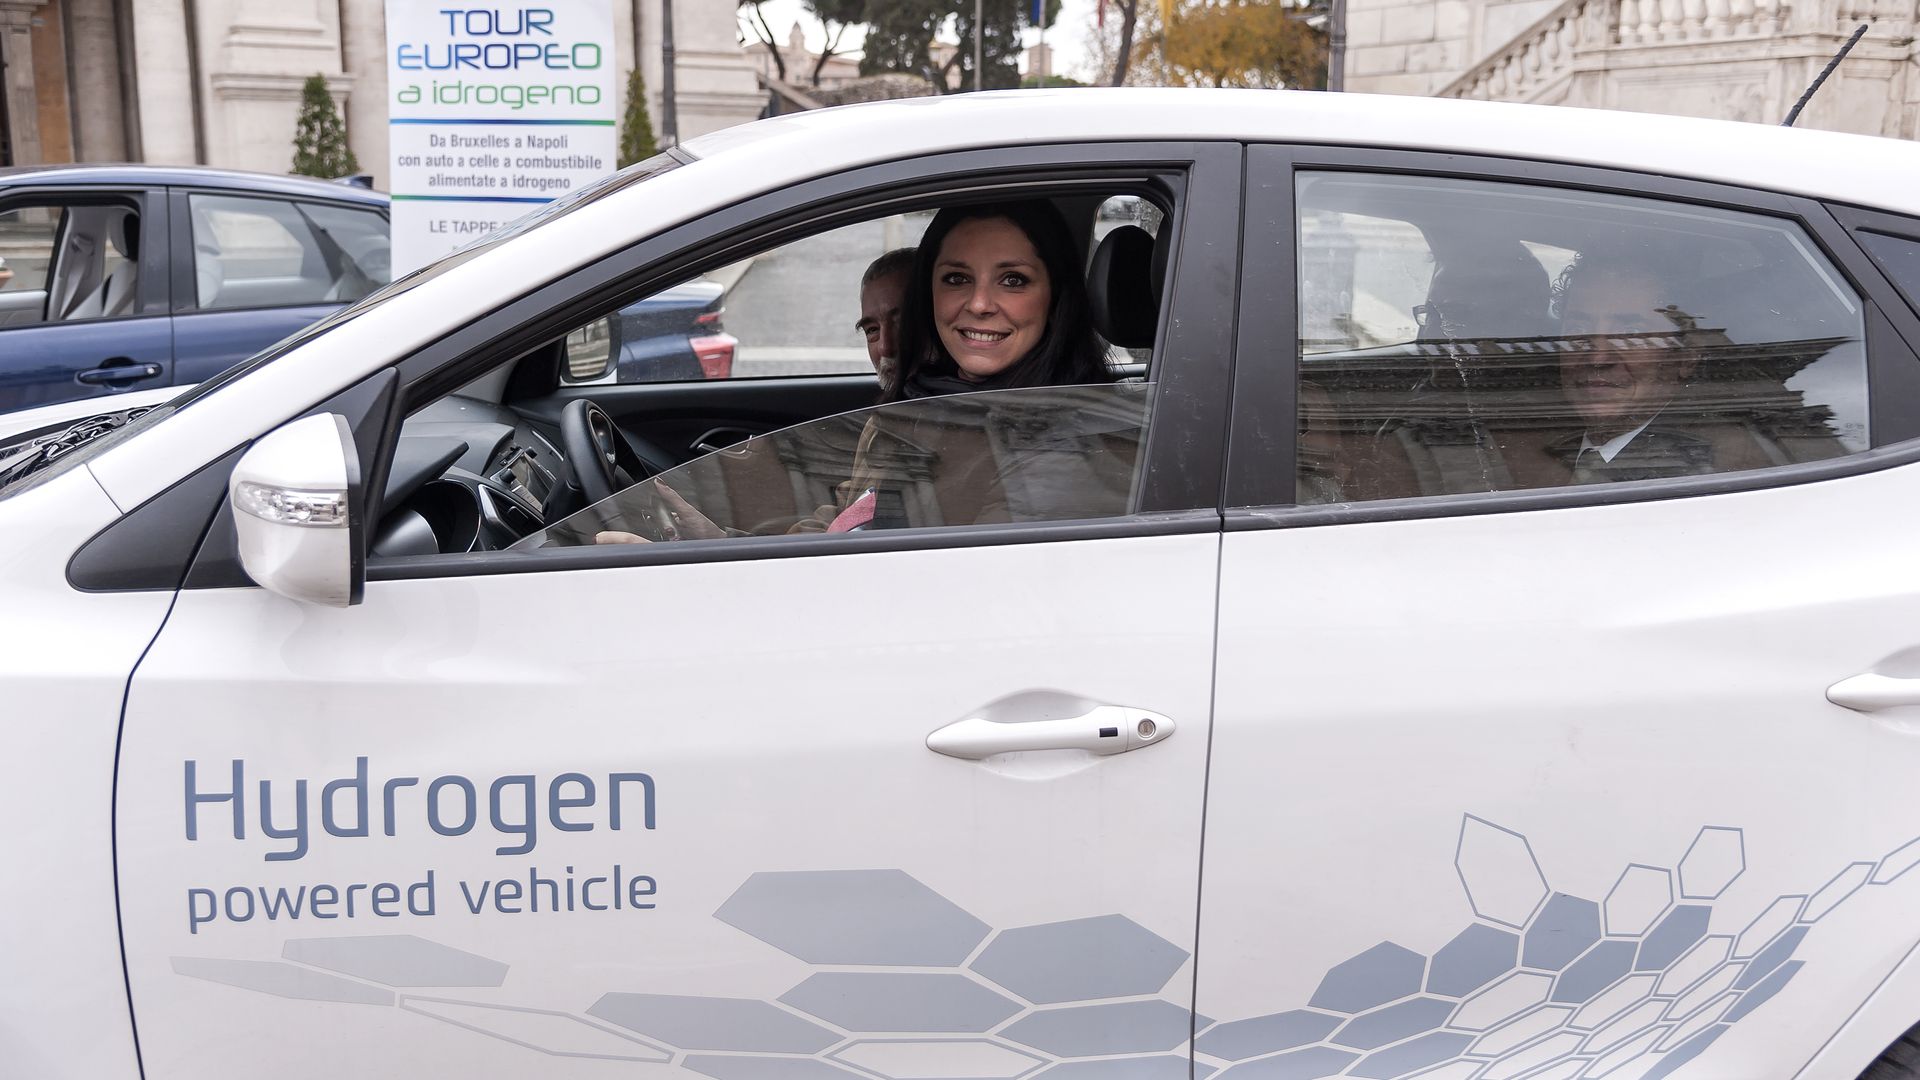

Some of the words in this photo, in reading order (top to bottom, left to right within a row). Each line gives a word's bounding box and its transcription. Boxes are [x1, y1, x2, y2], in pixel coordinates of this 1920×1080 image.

[440, 9, 554, 36] TOUR
[397, 43, 601, 70] EUROPEO
[397, 85, 421, 104] a
[432, 80, 601, 109] idrogeno
[430, 134, 446, 148] Da
[451, 134, 510, 148] Bruxelles
[515, 137, 522, 148] a
[527, 135, 568, 151] Napoli
[398, 155, 421, 167] con
[426, 155, 454, 167] auto
[457, 156, 465, 168] a
[469, 154, 500, 168] celle
[504, 157, 511, 168] a
[516, 155, 602, 169] combustibile
[428, 174, 496, 188] alimentate
[500, 177, 508, 188] a
[513, 175, 570, 191] idrogeno
[430, 220, 447, 233] LE
[184, 756, 656, 862] Hydrogen
[188, 870, 435, 935] powered
[459, 864, 657, 915] vehicle
